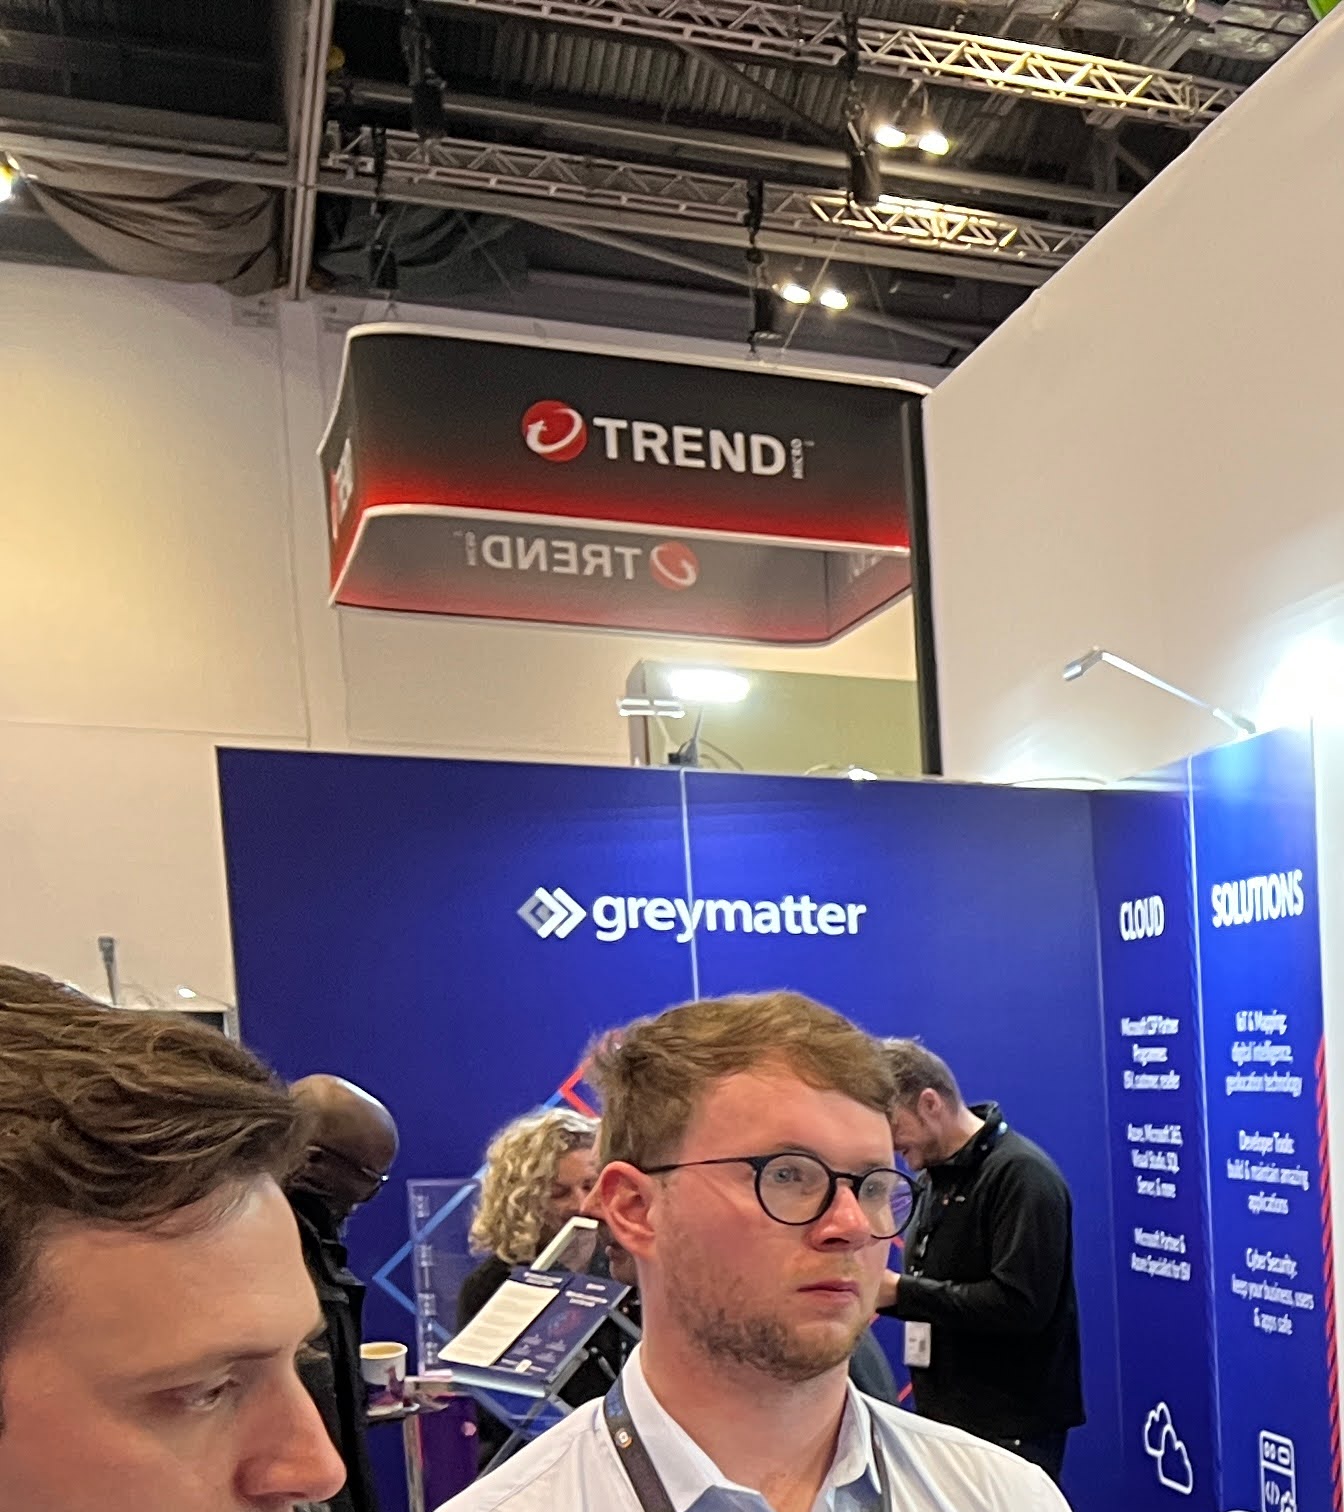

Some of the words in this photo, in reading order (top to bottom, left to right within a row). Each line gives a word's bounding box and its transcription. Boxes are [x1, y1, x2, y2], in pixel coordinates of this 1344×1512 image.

[592, 416, 786, 477] TREND
[592, 894, 867, 943] greymatter
[1120, 895, 1164, 941] CLOUD
[1211, 869, 1304, 928] SOLUTIONS
